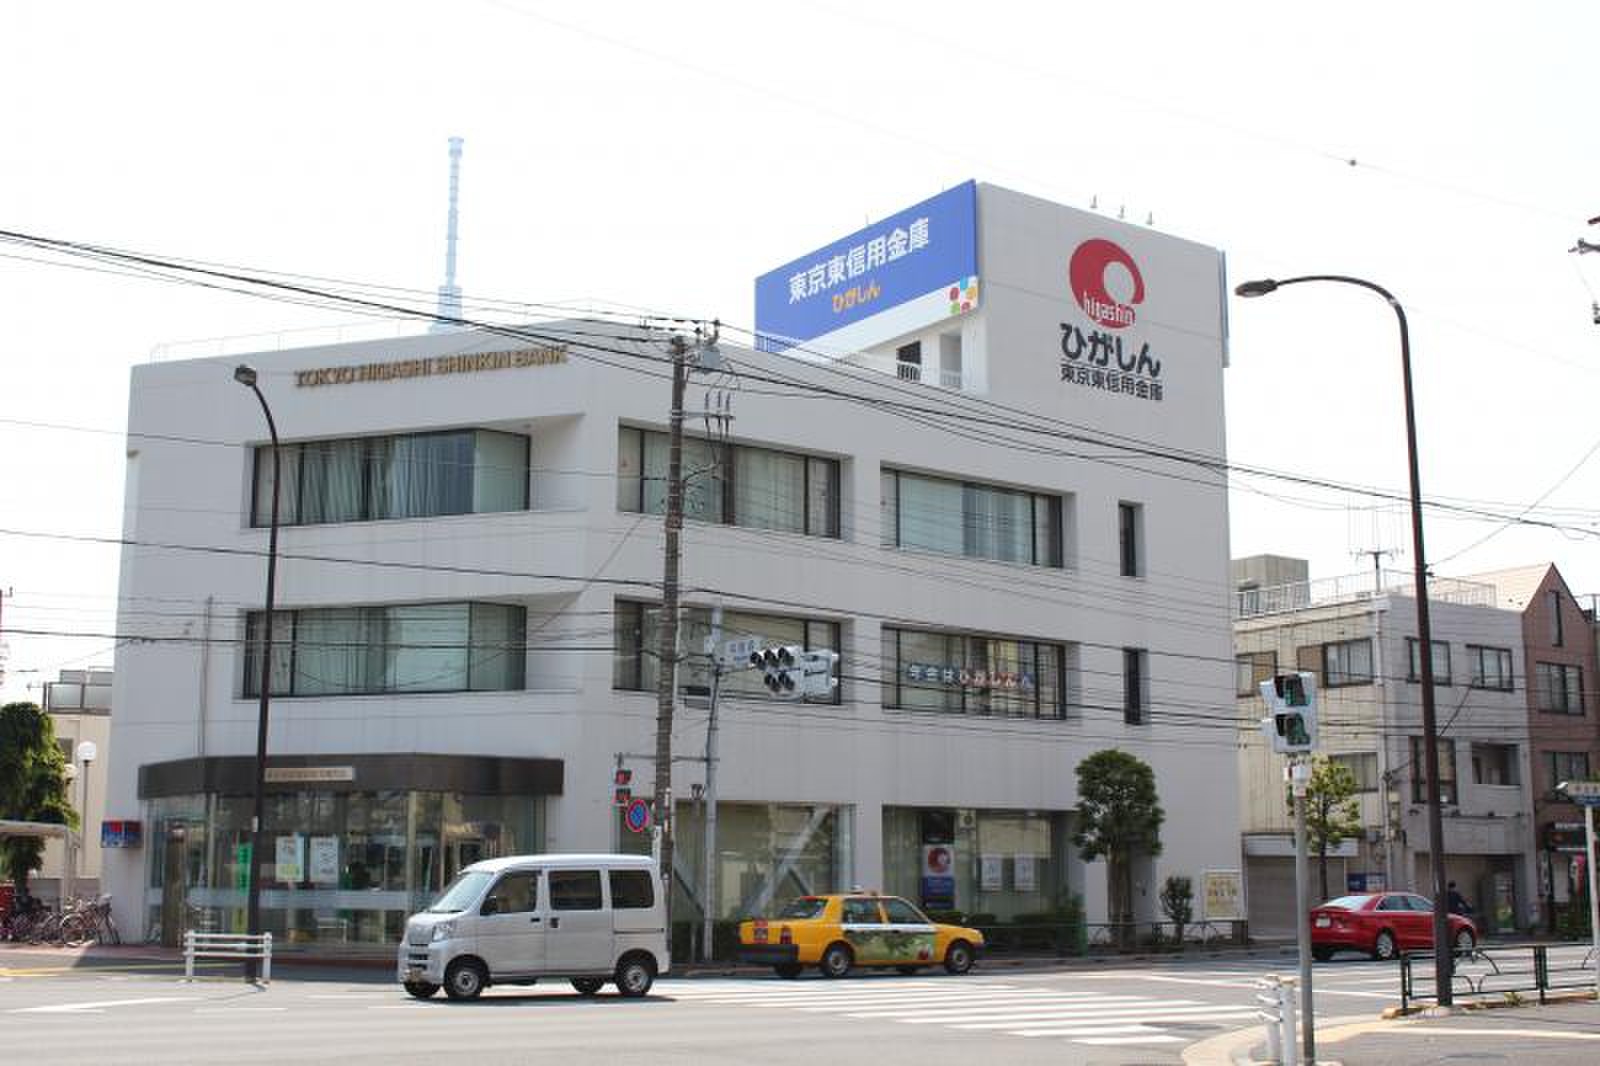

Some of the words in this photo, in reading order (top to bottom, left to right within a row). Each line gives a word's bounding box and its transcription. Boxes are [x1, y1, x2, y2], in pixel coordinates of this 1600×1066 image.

[788, 217, 930, 305] 東京東信用金庫
[831, 281, 881, 313] ひがしん
[294, 368, 355, 387] TOKYO
[359, 358, 433, 382] HIGASHI
[436, 351, 512, 375] SHINKIN
[514, 344, 569, 368] BANK
[1060, 322, 1161, 378] ひがしん
[1060, 364, 1163, 401] 東京東信用金庫
